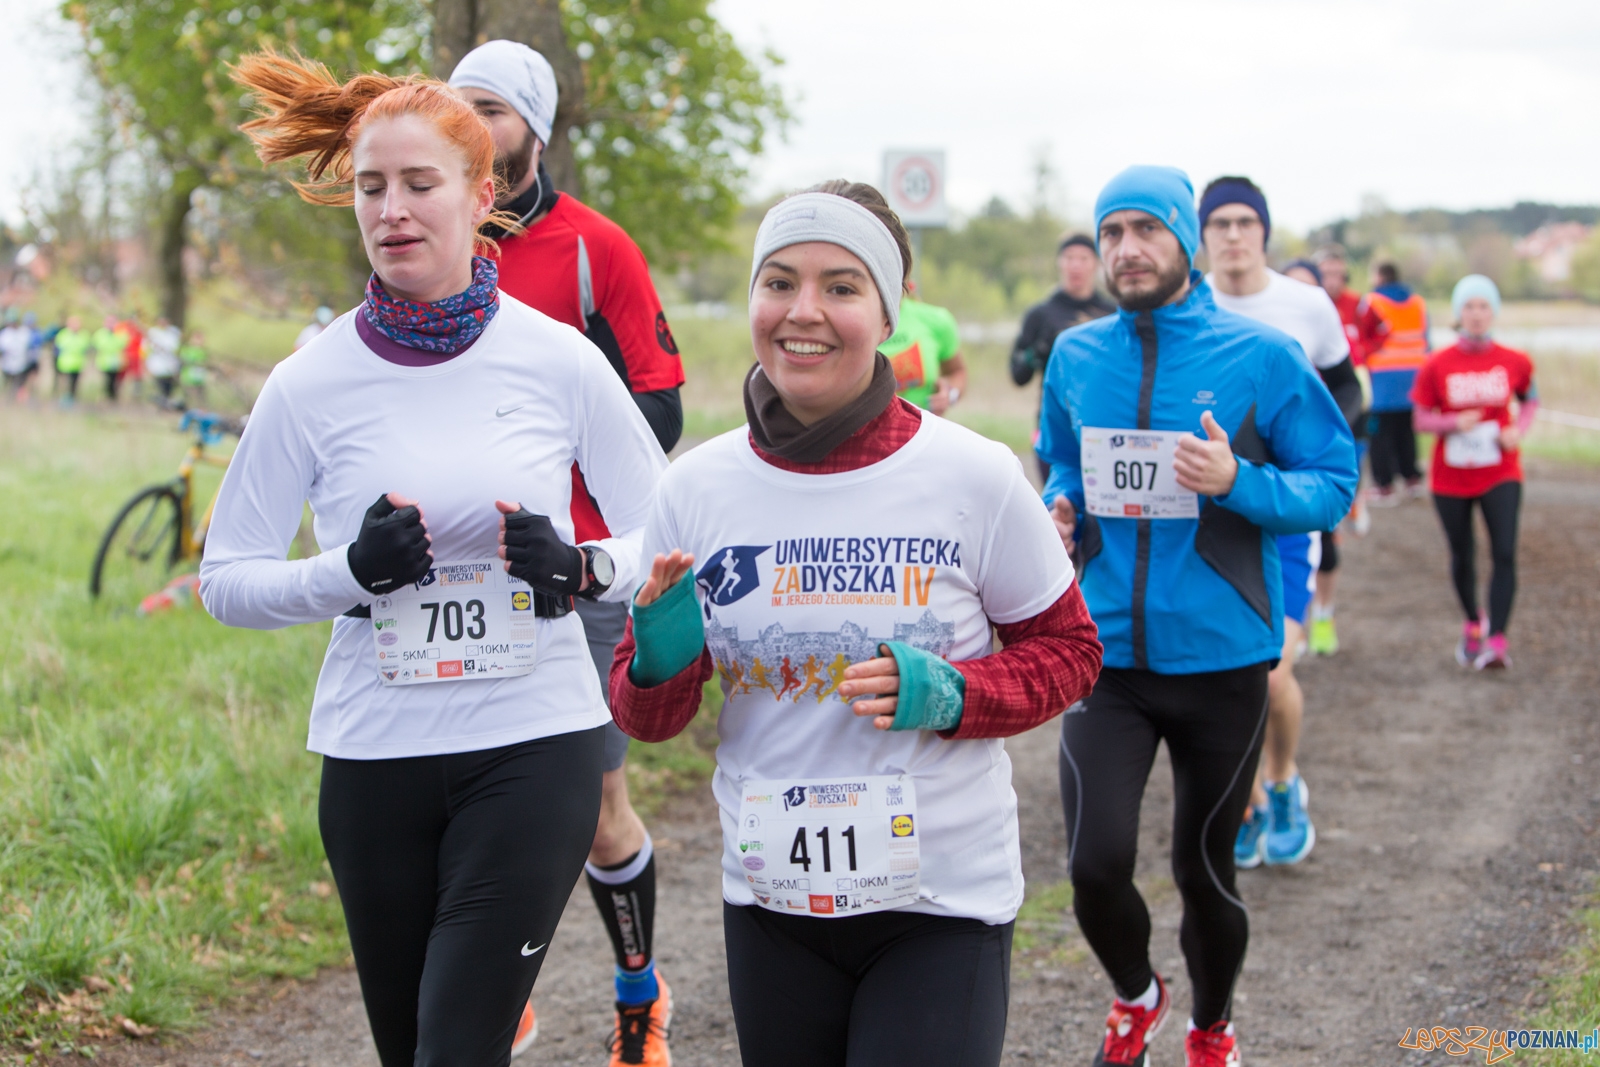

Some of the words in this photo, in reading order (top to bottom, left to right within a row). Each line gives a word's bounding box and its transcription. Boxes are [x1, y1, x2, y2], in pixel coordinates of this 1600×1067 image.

[1113, 460, 1158, 491] 607
[775, 537, 961, 568] UNIWERSYTECKA
[439, 563, 492, 576] UNIWERSYTECKA
[439, 572, 475, 583] ZADYSZKA
[475, 572, 485, 584] IV
[772, 564, 896, 595] ZADYSZKA
[903, 566, 936, 607] IV
[771, 596, 784, 607] IM.
[786, 594, 823, 606] JERZEGO
[825, 592, 897, 606] ŻELIGOWSKIEGO
[420, 599, 486, 643] 703
[402, 650, 427, 661] 5KM
[479, 644, 510, 655] 10KM
[808, 783, 868, 794] UNIWERSYTECKA
[809, 794, 847, 805] ZADYSZKA
[848, 793, 859, 807] IV
[789, 825, 857, 873] 411
[772, 879, 798, 890] 5KM
[852, 876, 888, 889] 10KM
